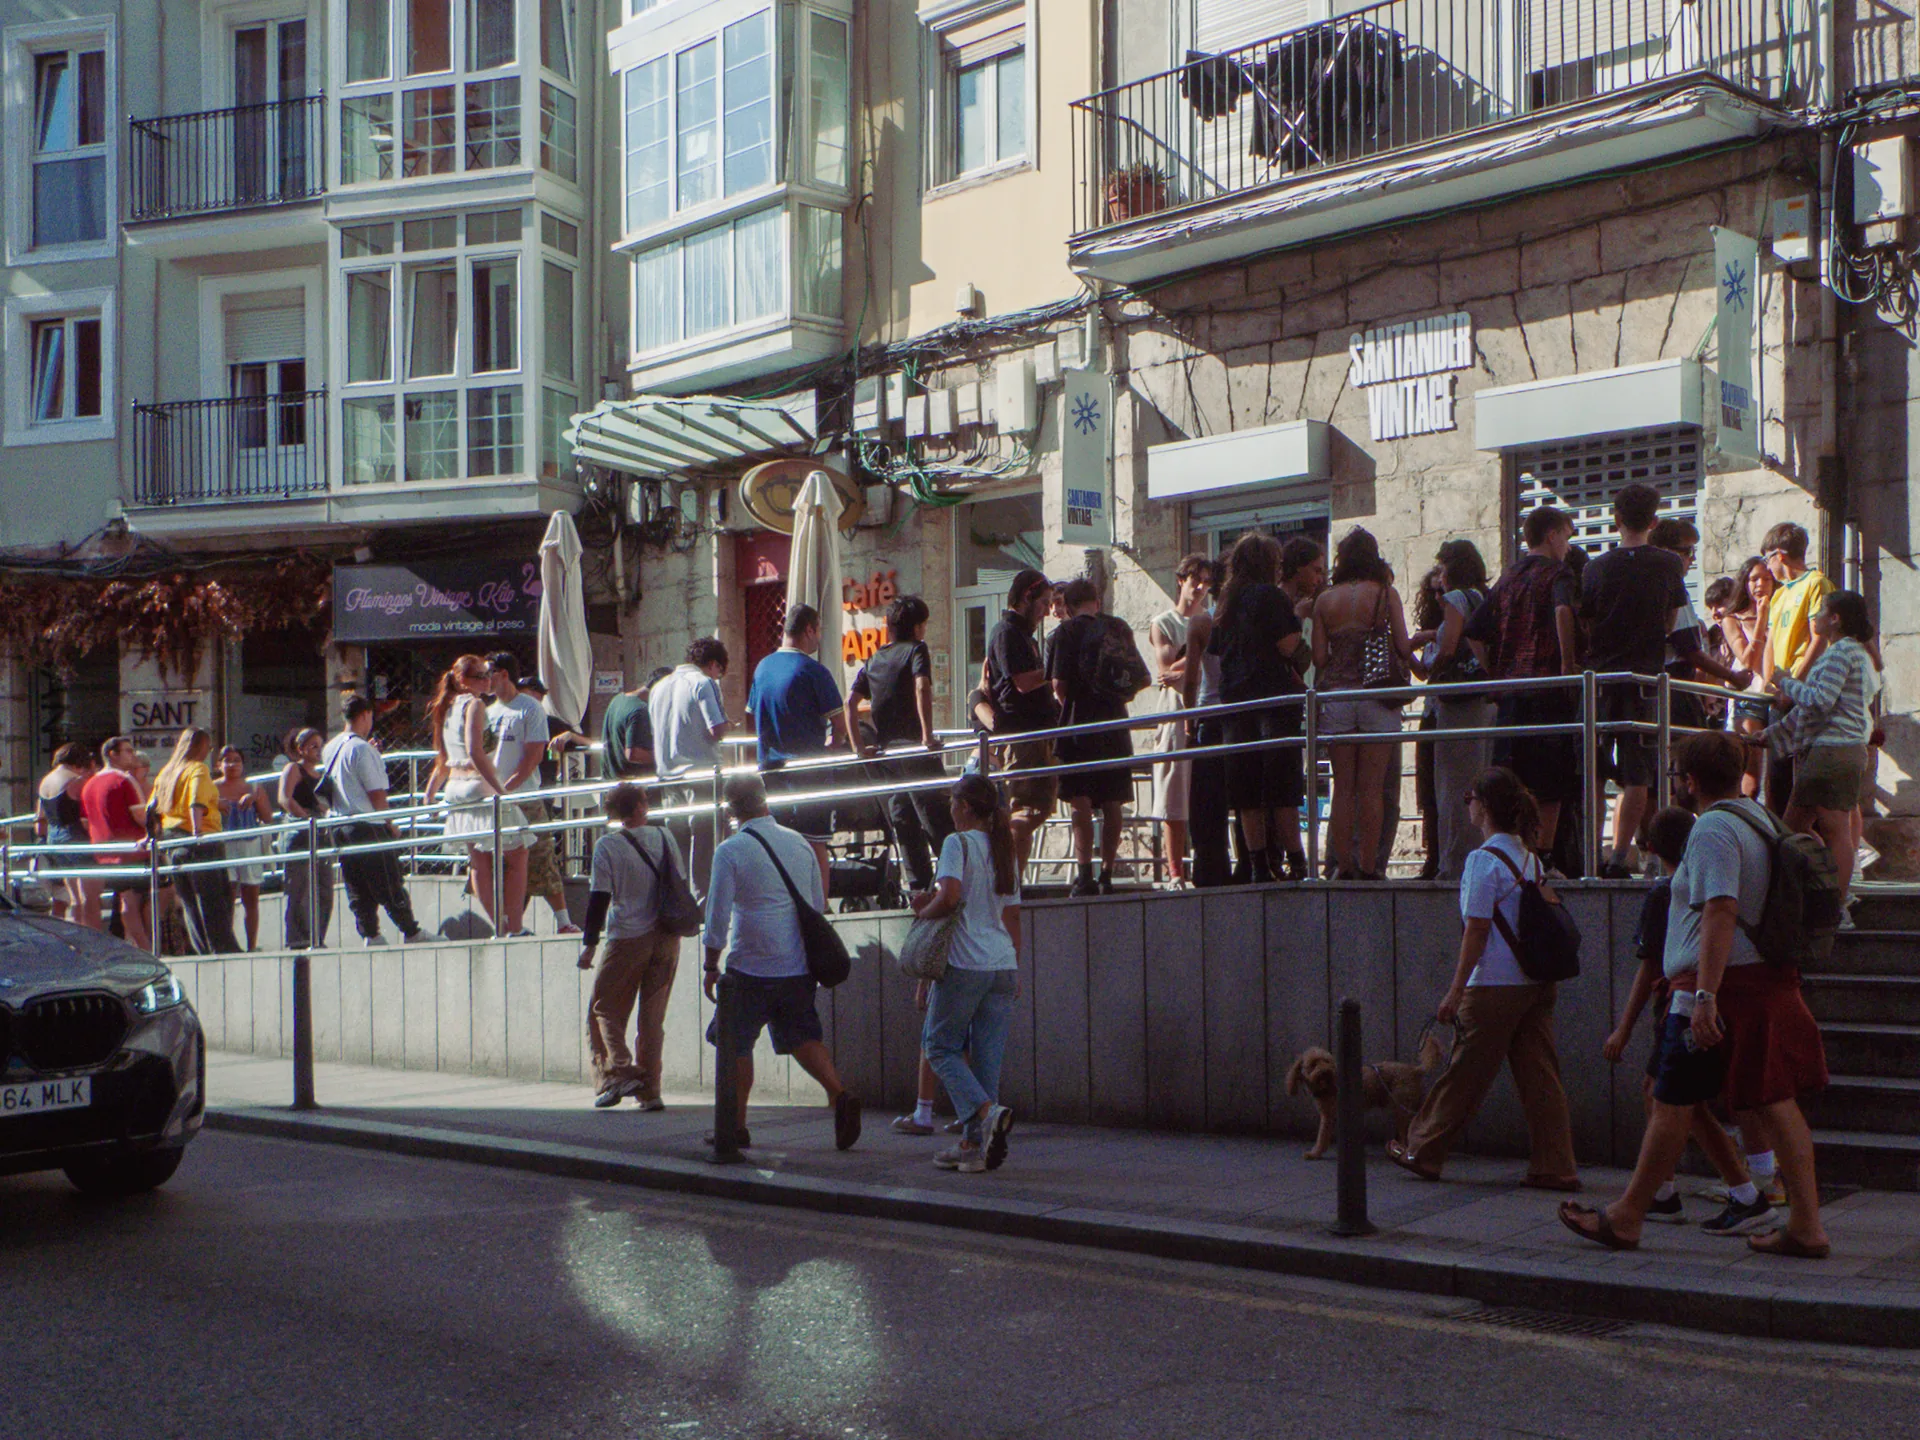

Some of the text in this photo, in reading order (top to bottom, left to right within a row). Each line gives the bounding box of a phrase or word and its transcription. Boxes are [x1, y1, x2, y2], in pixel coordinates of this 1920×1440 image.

[1349, 311, 1472, 387] SANTANDER
[1367, 373, 1455, 441] VINTAGE
[1067, 488, 1102, 509] SANTANDER
[1067, 507, 1093, 527] VINTAGE
[344, 587, 413, 615] Flamingos
[415, 583, 474, 612] Vintage
[409, 618, 526, 633] moda vintage al peso
[132, 700, 198, 726] SANT
[41, 1080, 84, 1106] MLK
